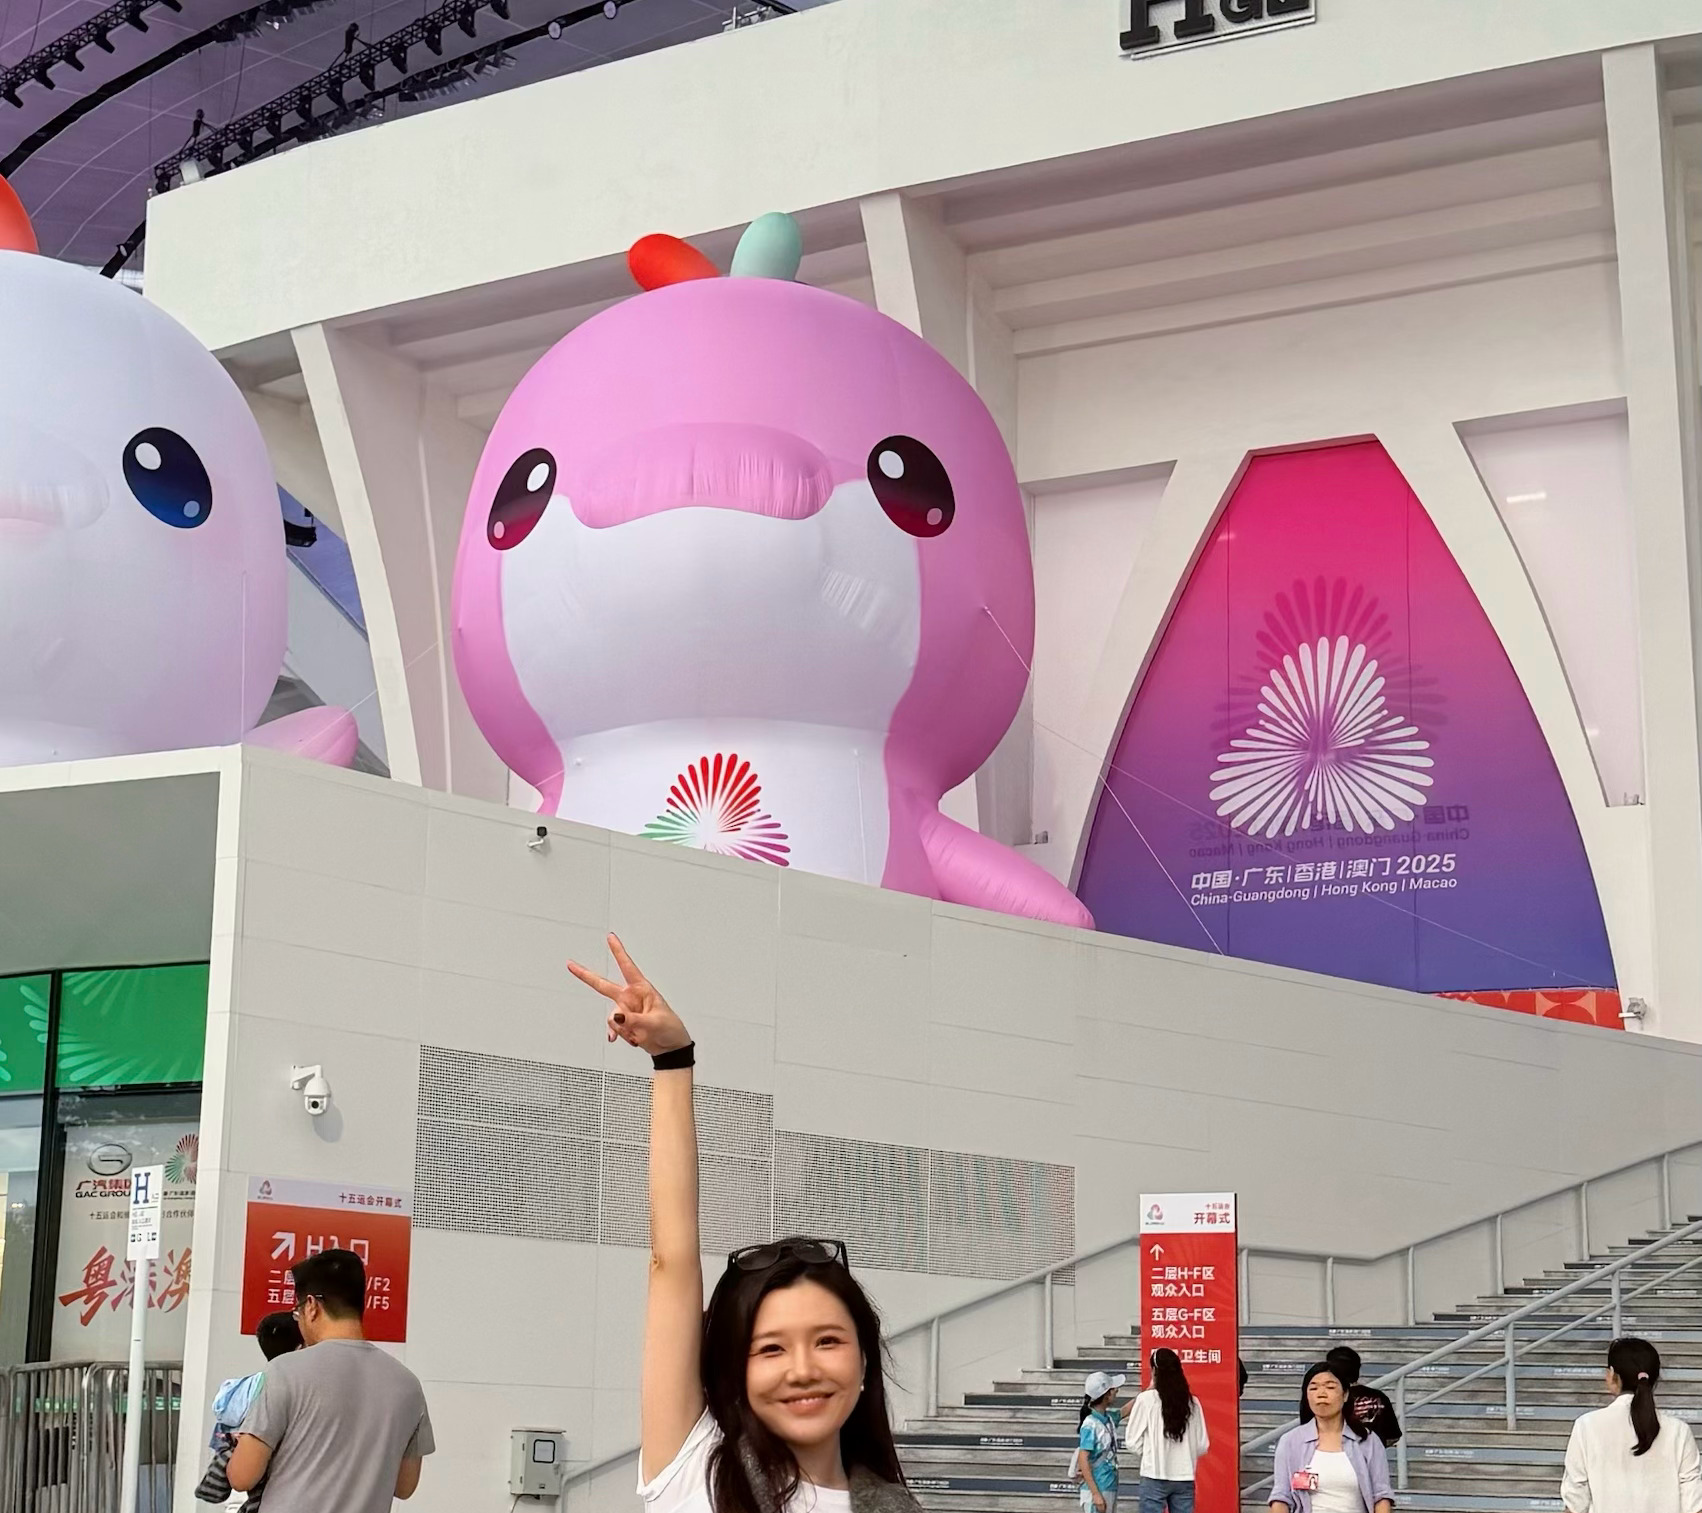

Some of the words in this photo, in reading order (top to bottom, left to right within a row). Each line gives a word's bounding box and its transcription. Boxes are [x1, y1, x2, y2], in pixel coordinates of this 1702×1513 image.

[1396, 853, 1456, 875] 2025
[1191, 887, 1310, 906] China-Guangdong
[1321, 884, 1358, 896] Hong
[1361, 881, 1397, 894] Kong
[1409, 878, 1457, 890] Macao
[75, 1190, 98, 1198] GAC
[99, 1189, 130, 1198] GROU
[133, 1172, 151, 1204] H
[1193, 1212, 1231, 1225] 开幕式
[1150, 1266, 1216, 1281] 二层H-F区
[1150, 1283, 1205, 1298] 观众入口
[1151, 1308, 1216, 1322] 五层G-F区
[1151, 1324, 1205, 1339] 观众入口
